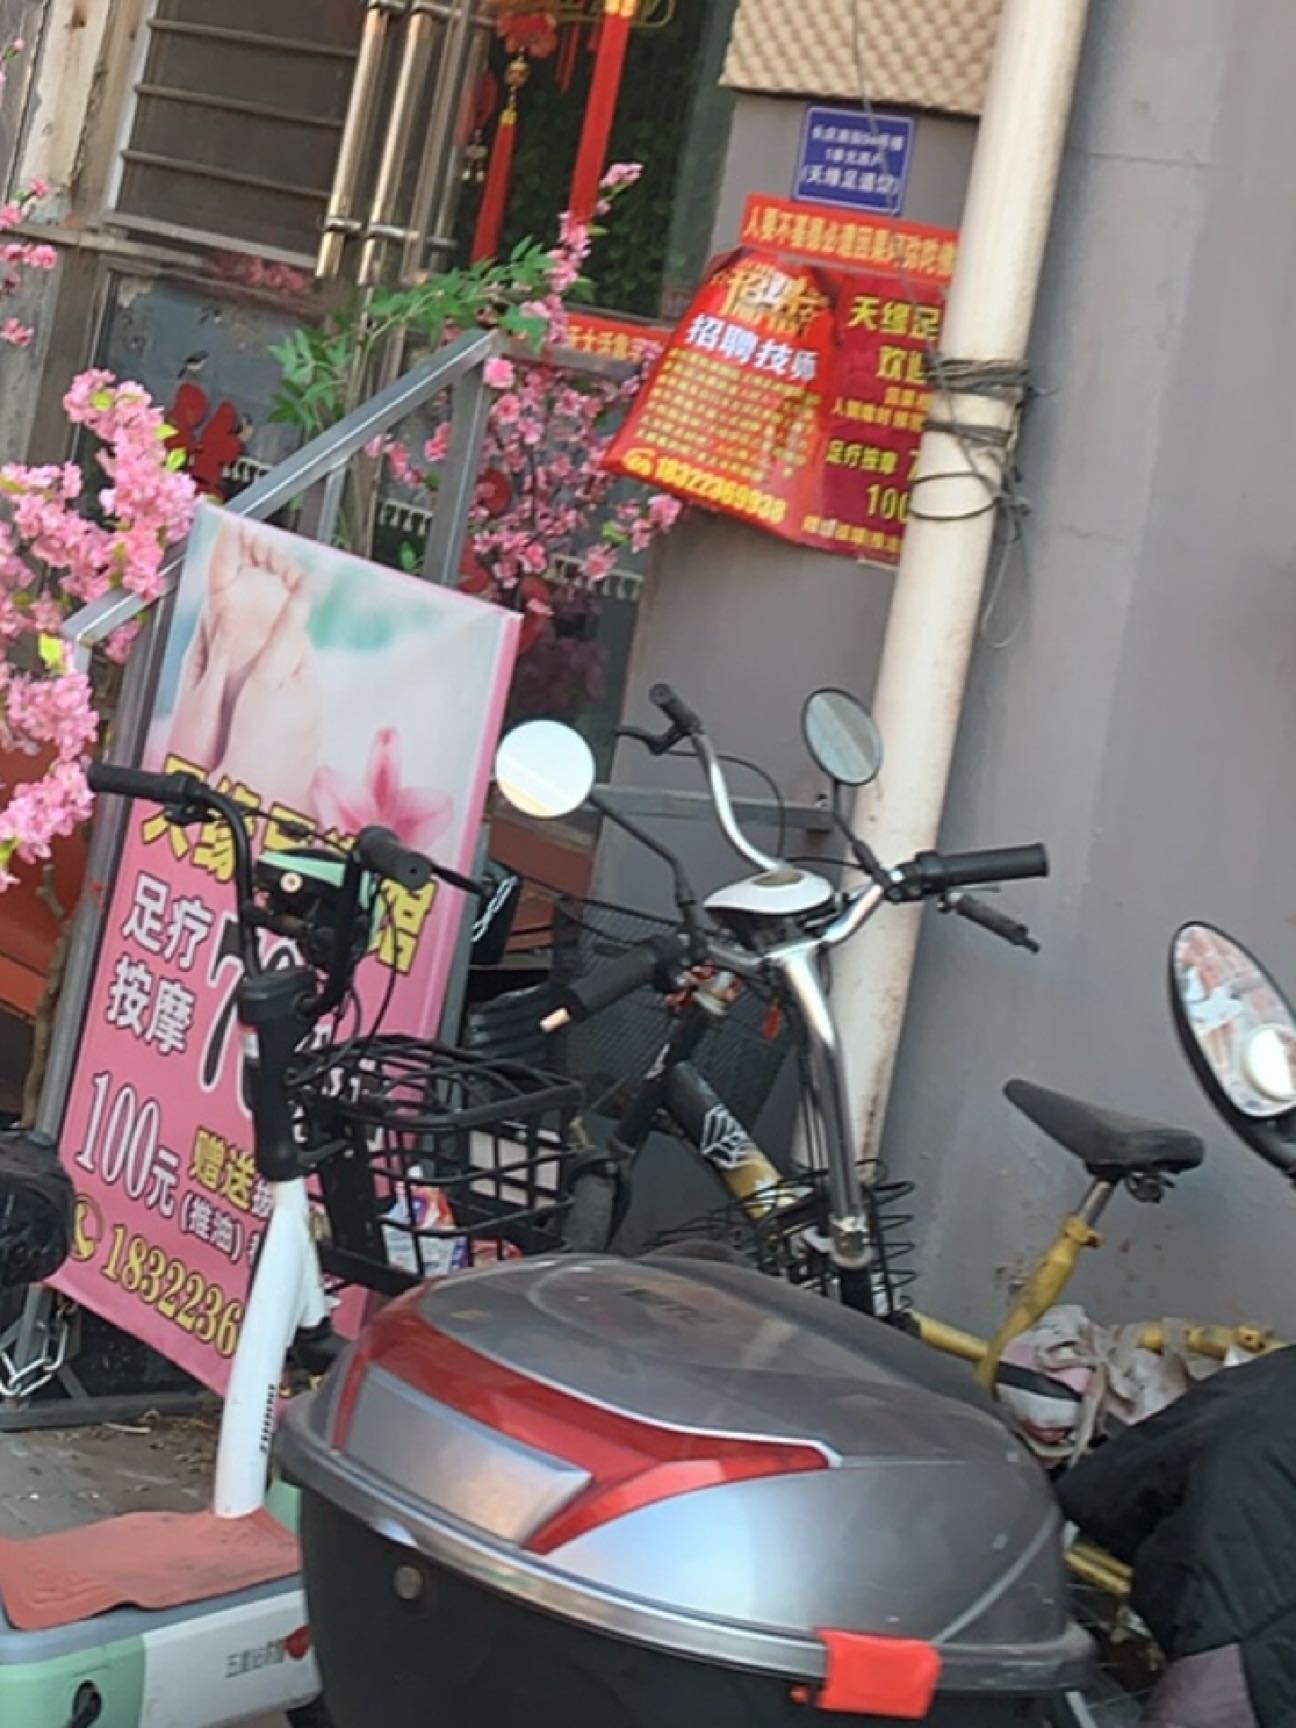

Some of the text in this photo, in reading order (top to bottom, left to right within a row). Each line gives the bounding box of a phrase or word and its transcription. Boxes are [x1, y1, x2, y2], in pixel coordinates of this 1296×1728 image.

[684, 313, 820, 383] 招聘技师
[123, 869, 217, 970] 足疗
[106, 955, 197, 1056] 按摩
[74, 1070, 181, 1217] 100元
